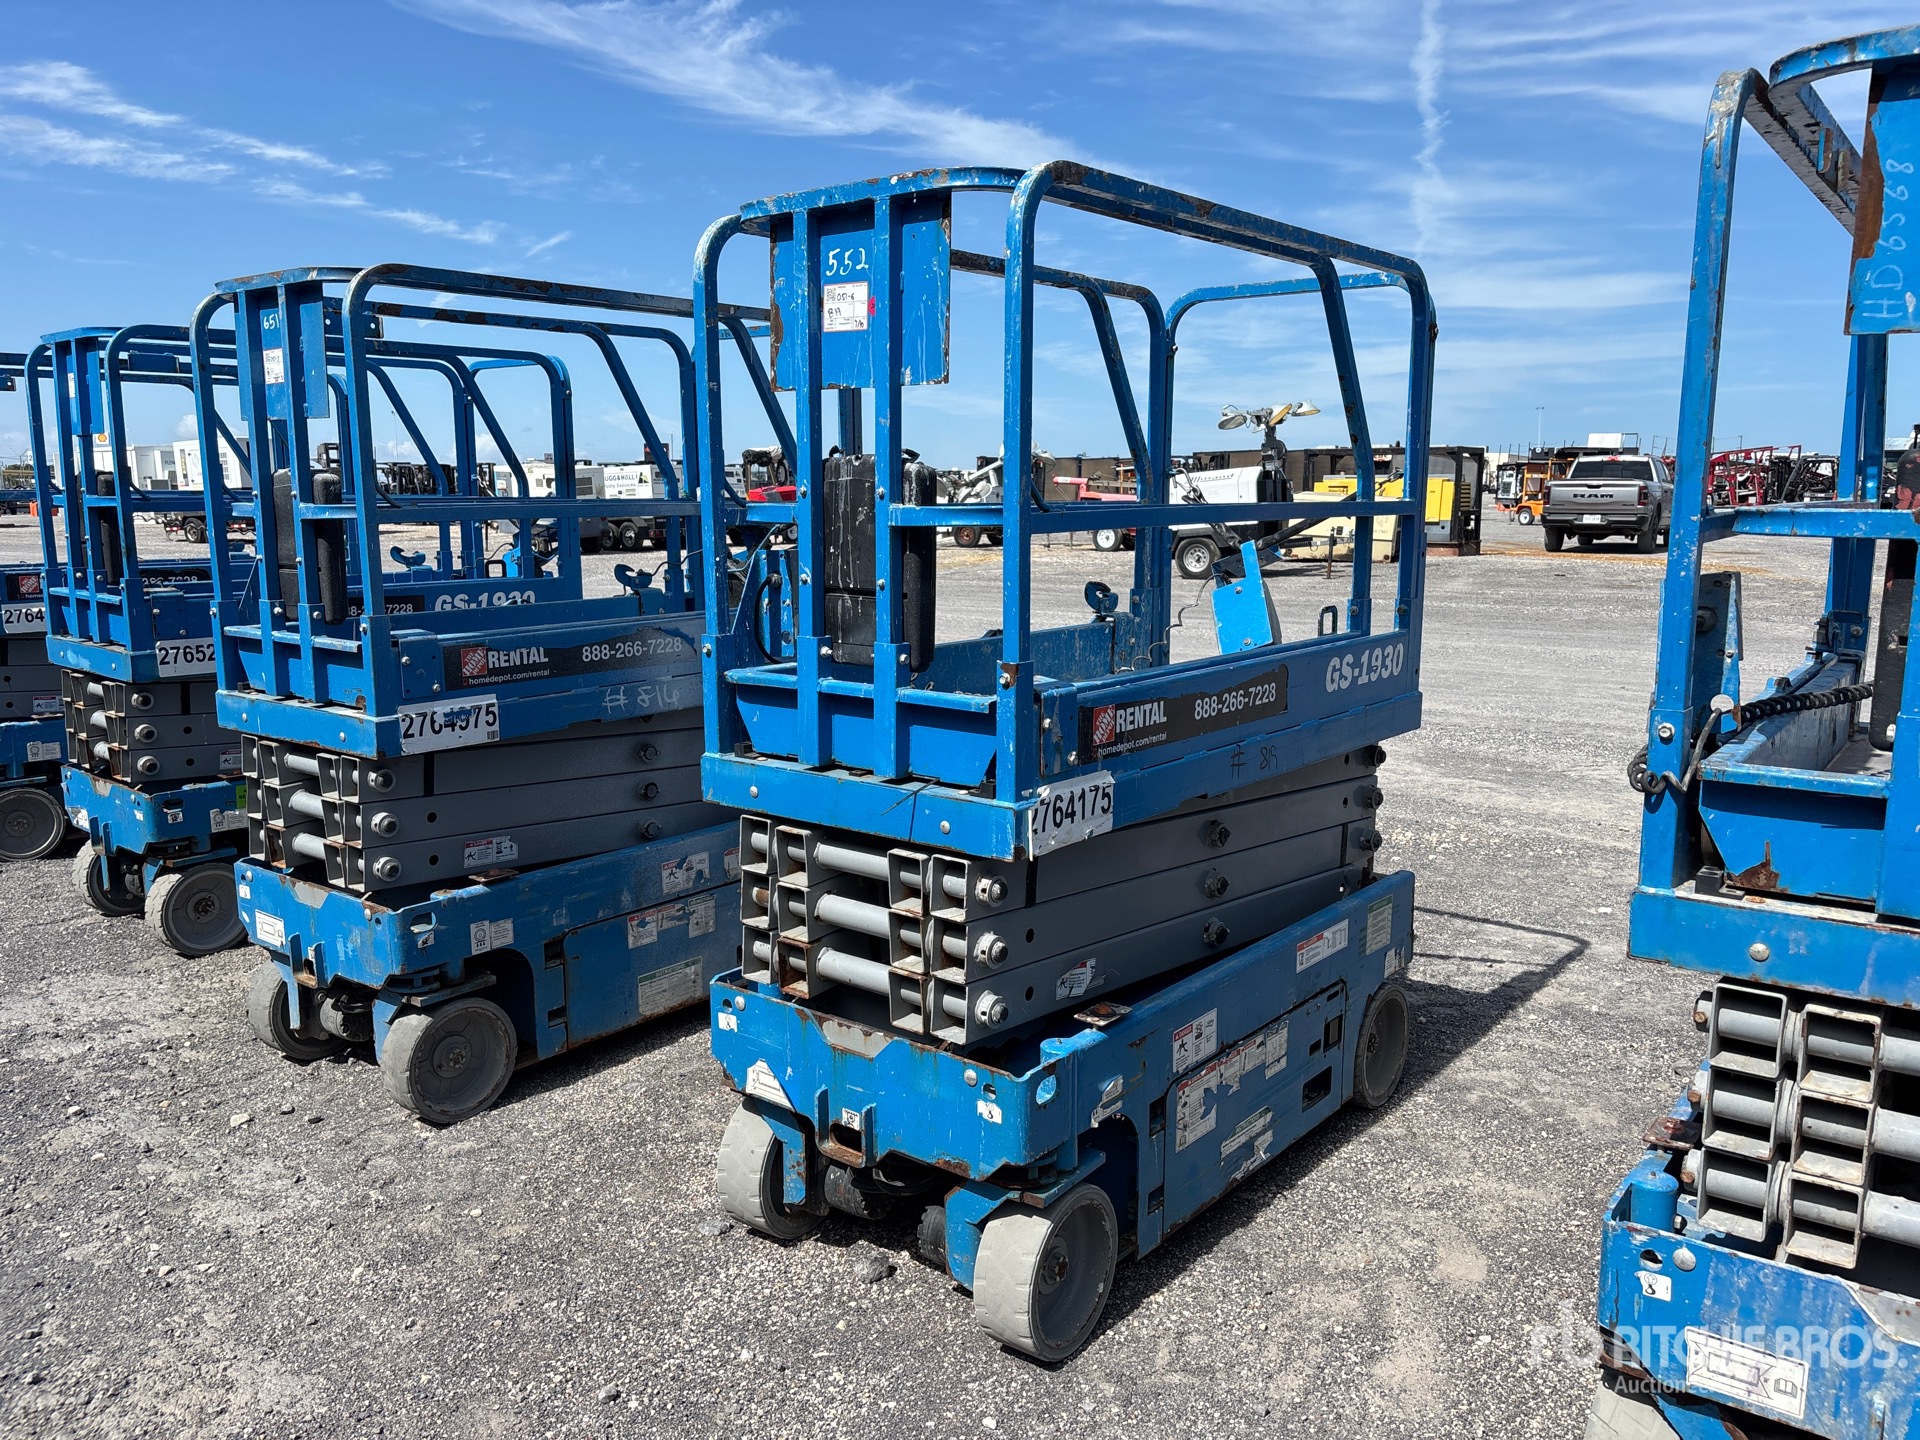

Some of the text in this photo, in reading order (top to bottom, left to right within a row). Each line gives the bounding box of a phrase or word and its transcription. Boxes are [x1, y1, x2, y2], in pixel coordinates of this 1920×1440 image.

[826, 248, 869, 277] 552
[263, 313, 280, 330] 651
[487, 646, 549, 669] RENTAL
[582, 637, 683, 662] 888-266-7228
[468, 668, 550, 686] homedepot.com/rental
[1325, 642, 1404, 693] GS-1930
[1194, 682, 1276, 720] 888-266-7228
[1115, 700, 1168, 734] RENTAL
[1097, 731, 1167, 758] homedepot.com/rental
